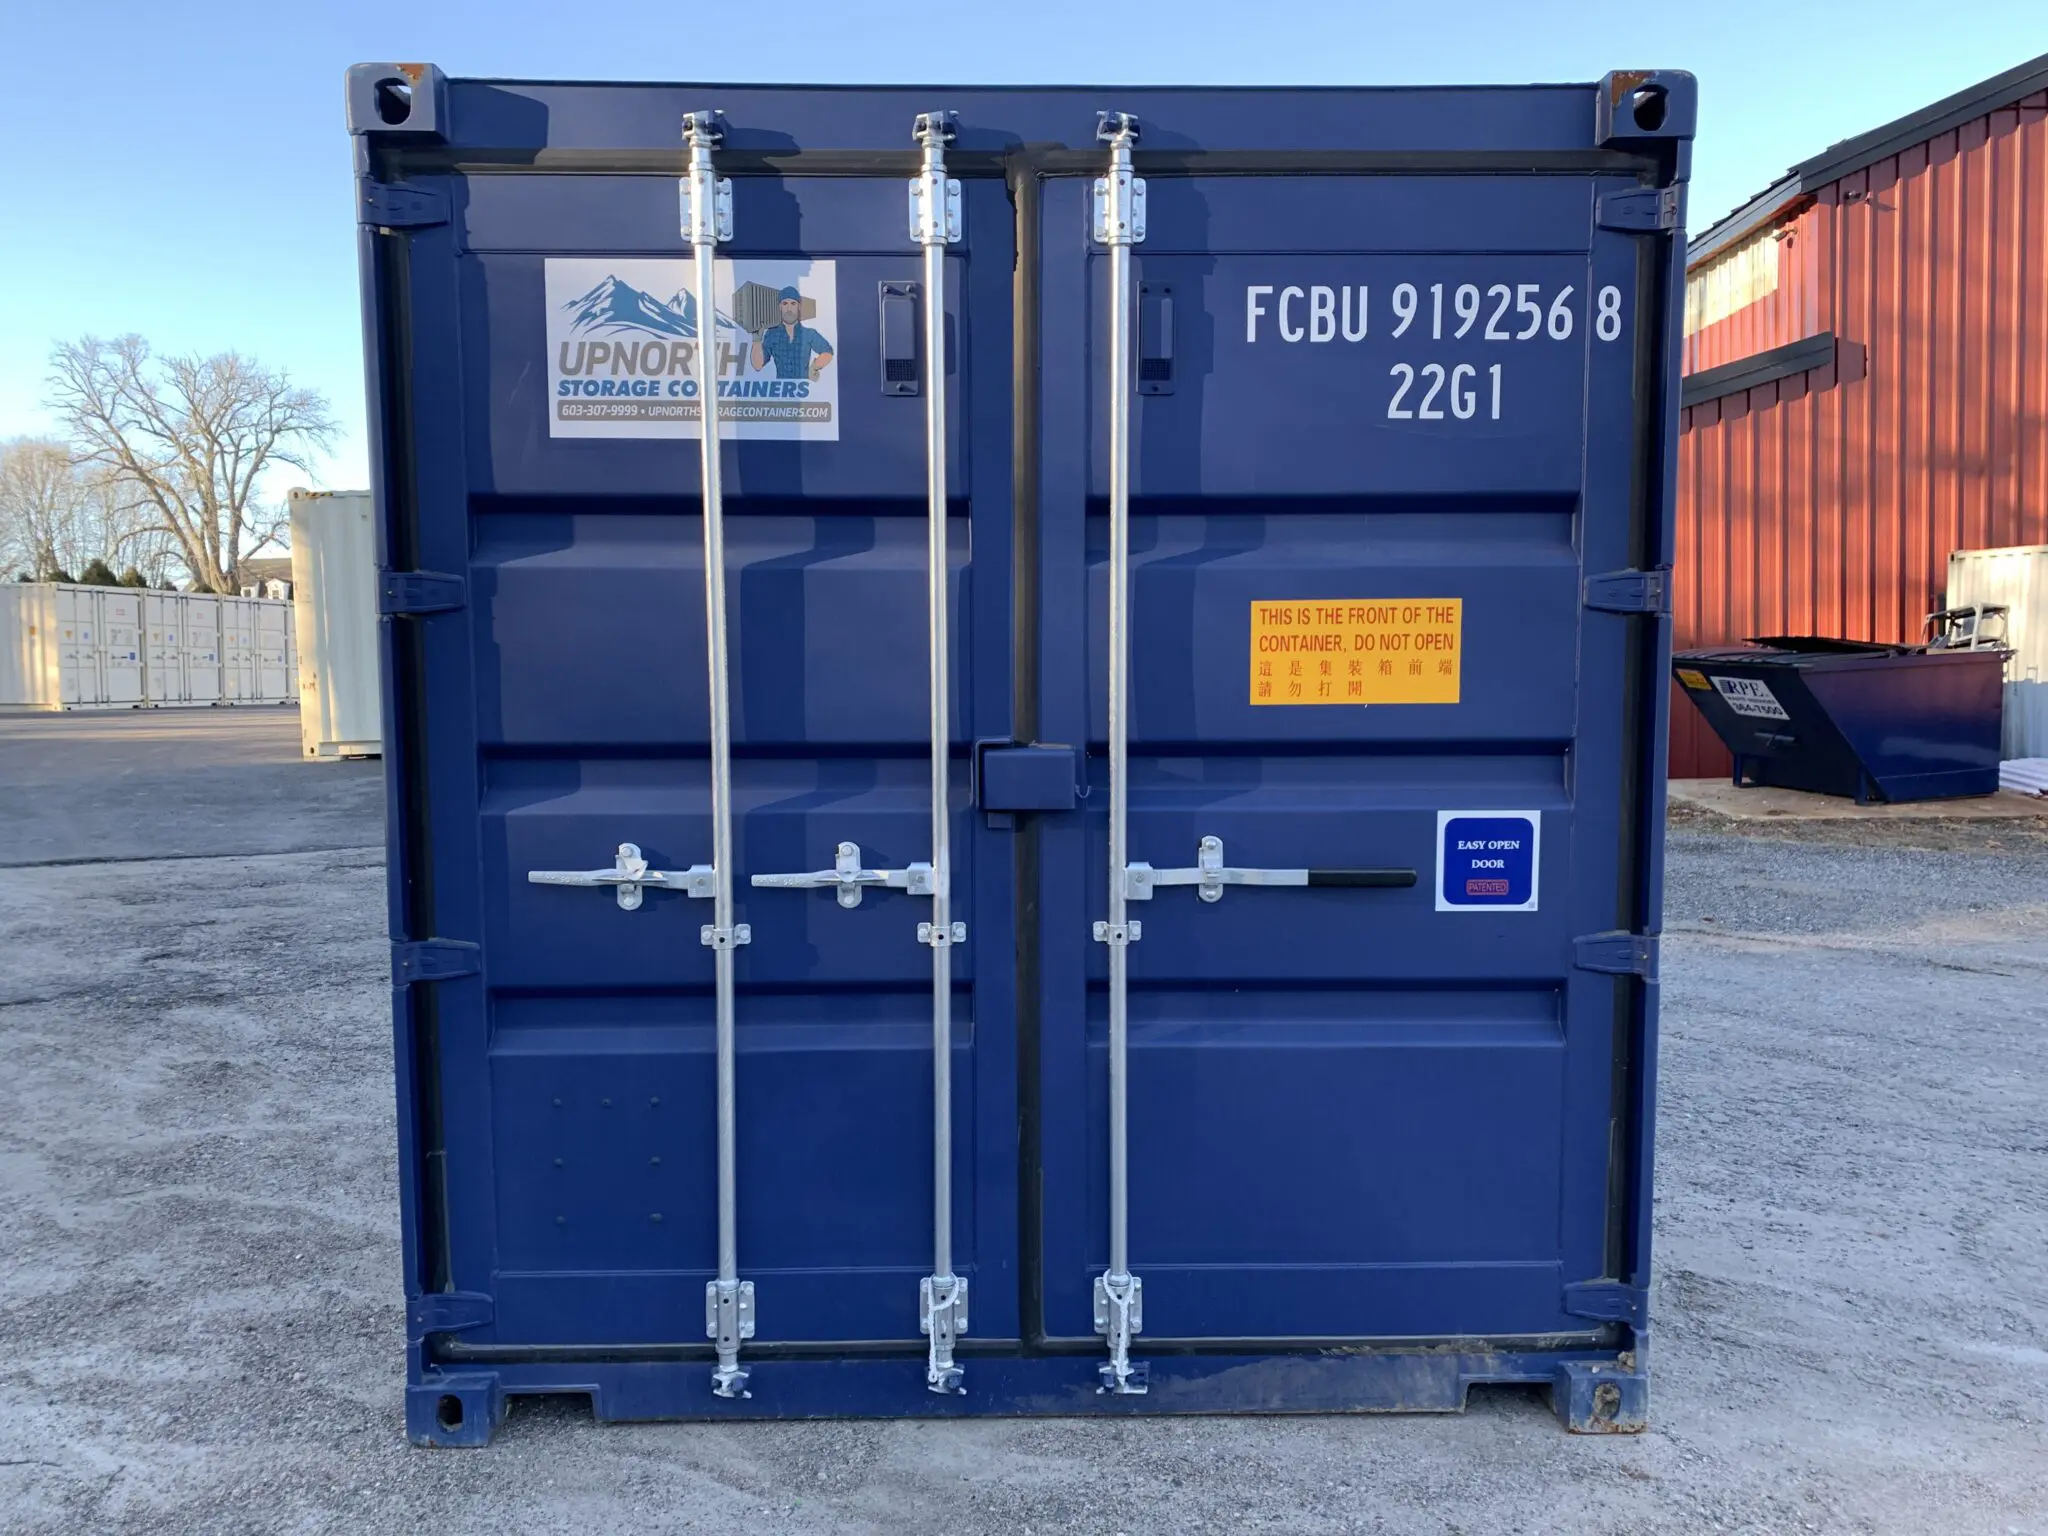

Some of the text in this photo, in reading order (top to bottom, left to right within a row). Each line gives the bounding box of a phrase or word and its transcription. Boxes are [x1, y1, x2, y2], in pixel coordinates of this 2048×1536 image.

[1246, 282, 1622, 343] FCBU 919256 8
[557, 379, 810, 398] STORAGE COTAINERS
[1387, 362, 1502, 420] 22G1
[561, 404, 829, 419] 603-307-9999 UPNORTHSRAGECONTAINERS.COM
[1260, 606, 1454, 625] THIS IS THE FRONT OF THE
[1259, 633, 1454, 653] CONTAINER, DO NOT OPEN
[1258, 680, 1362, 698] 請勿打開
[1457, 840, 1520, 850] EASY OPEN
[1471, 859, 1505, 869] DOOR
[1468, 882, 1506, 892] PATENTED
